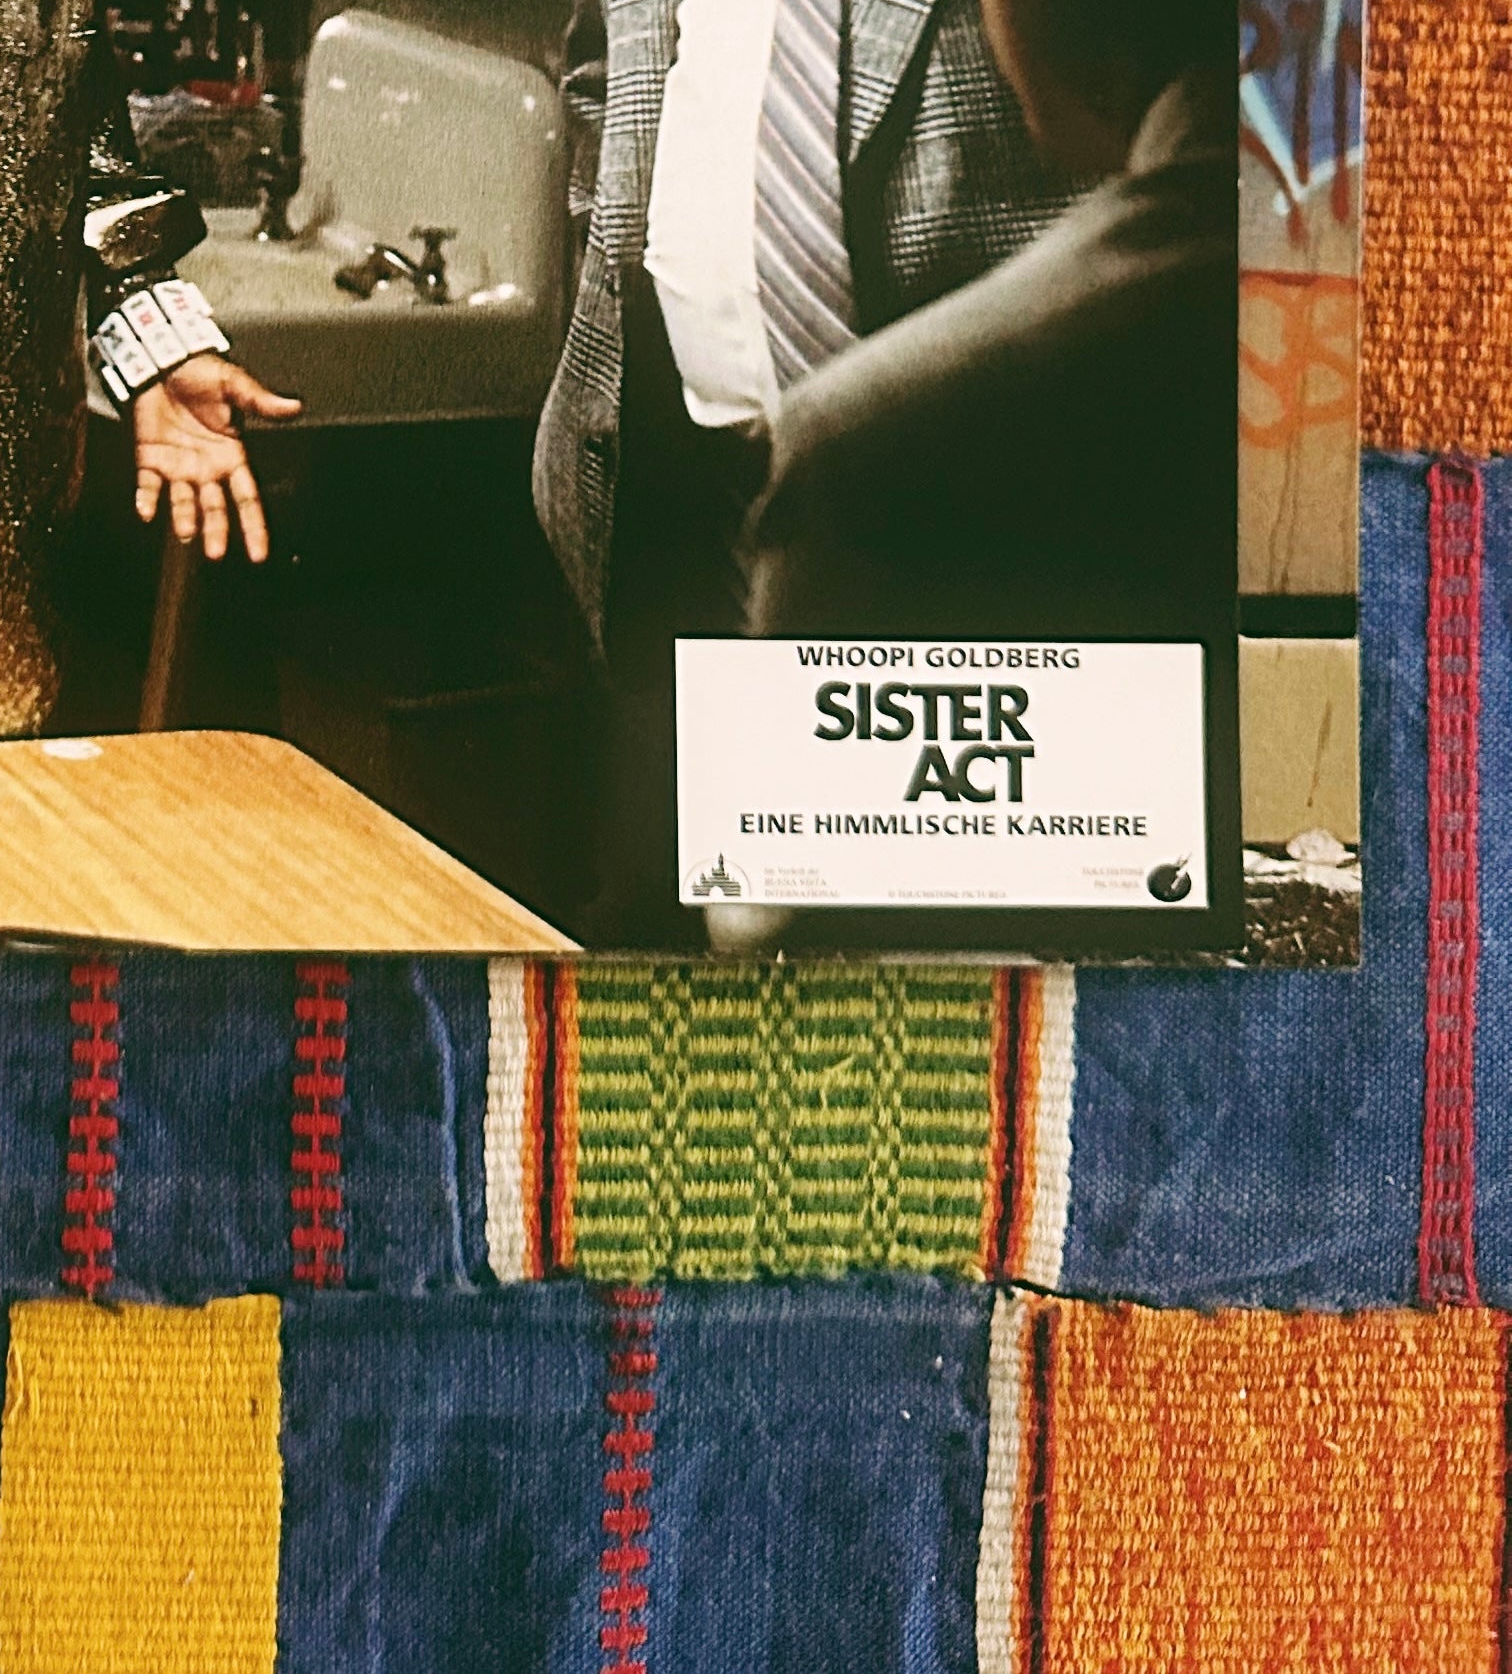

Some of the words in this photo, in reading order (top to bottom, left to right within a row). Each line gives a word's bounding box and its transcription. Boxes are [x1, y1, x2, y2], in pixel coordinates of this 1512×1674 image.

[796, 644, 915, 668] WHOOPI
[925, 646, 1081, 670] GOLDBERG
[813, 680, 1035, 742] SISTER
[903, 743, 1036, 804] ACT
[740, 812, 803, 835] EINE
[815, 813, 996, 836] HIMMLISCHE
[1007, 814, 1148, 837] KARRIERE
